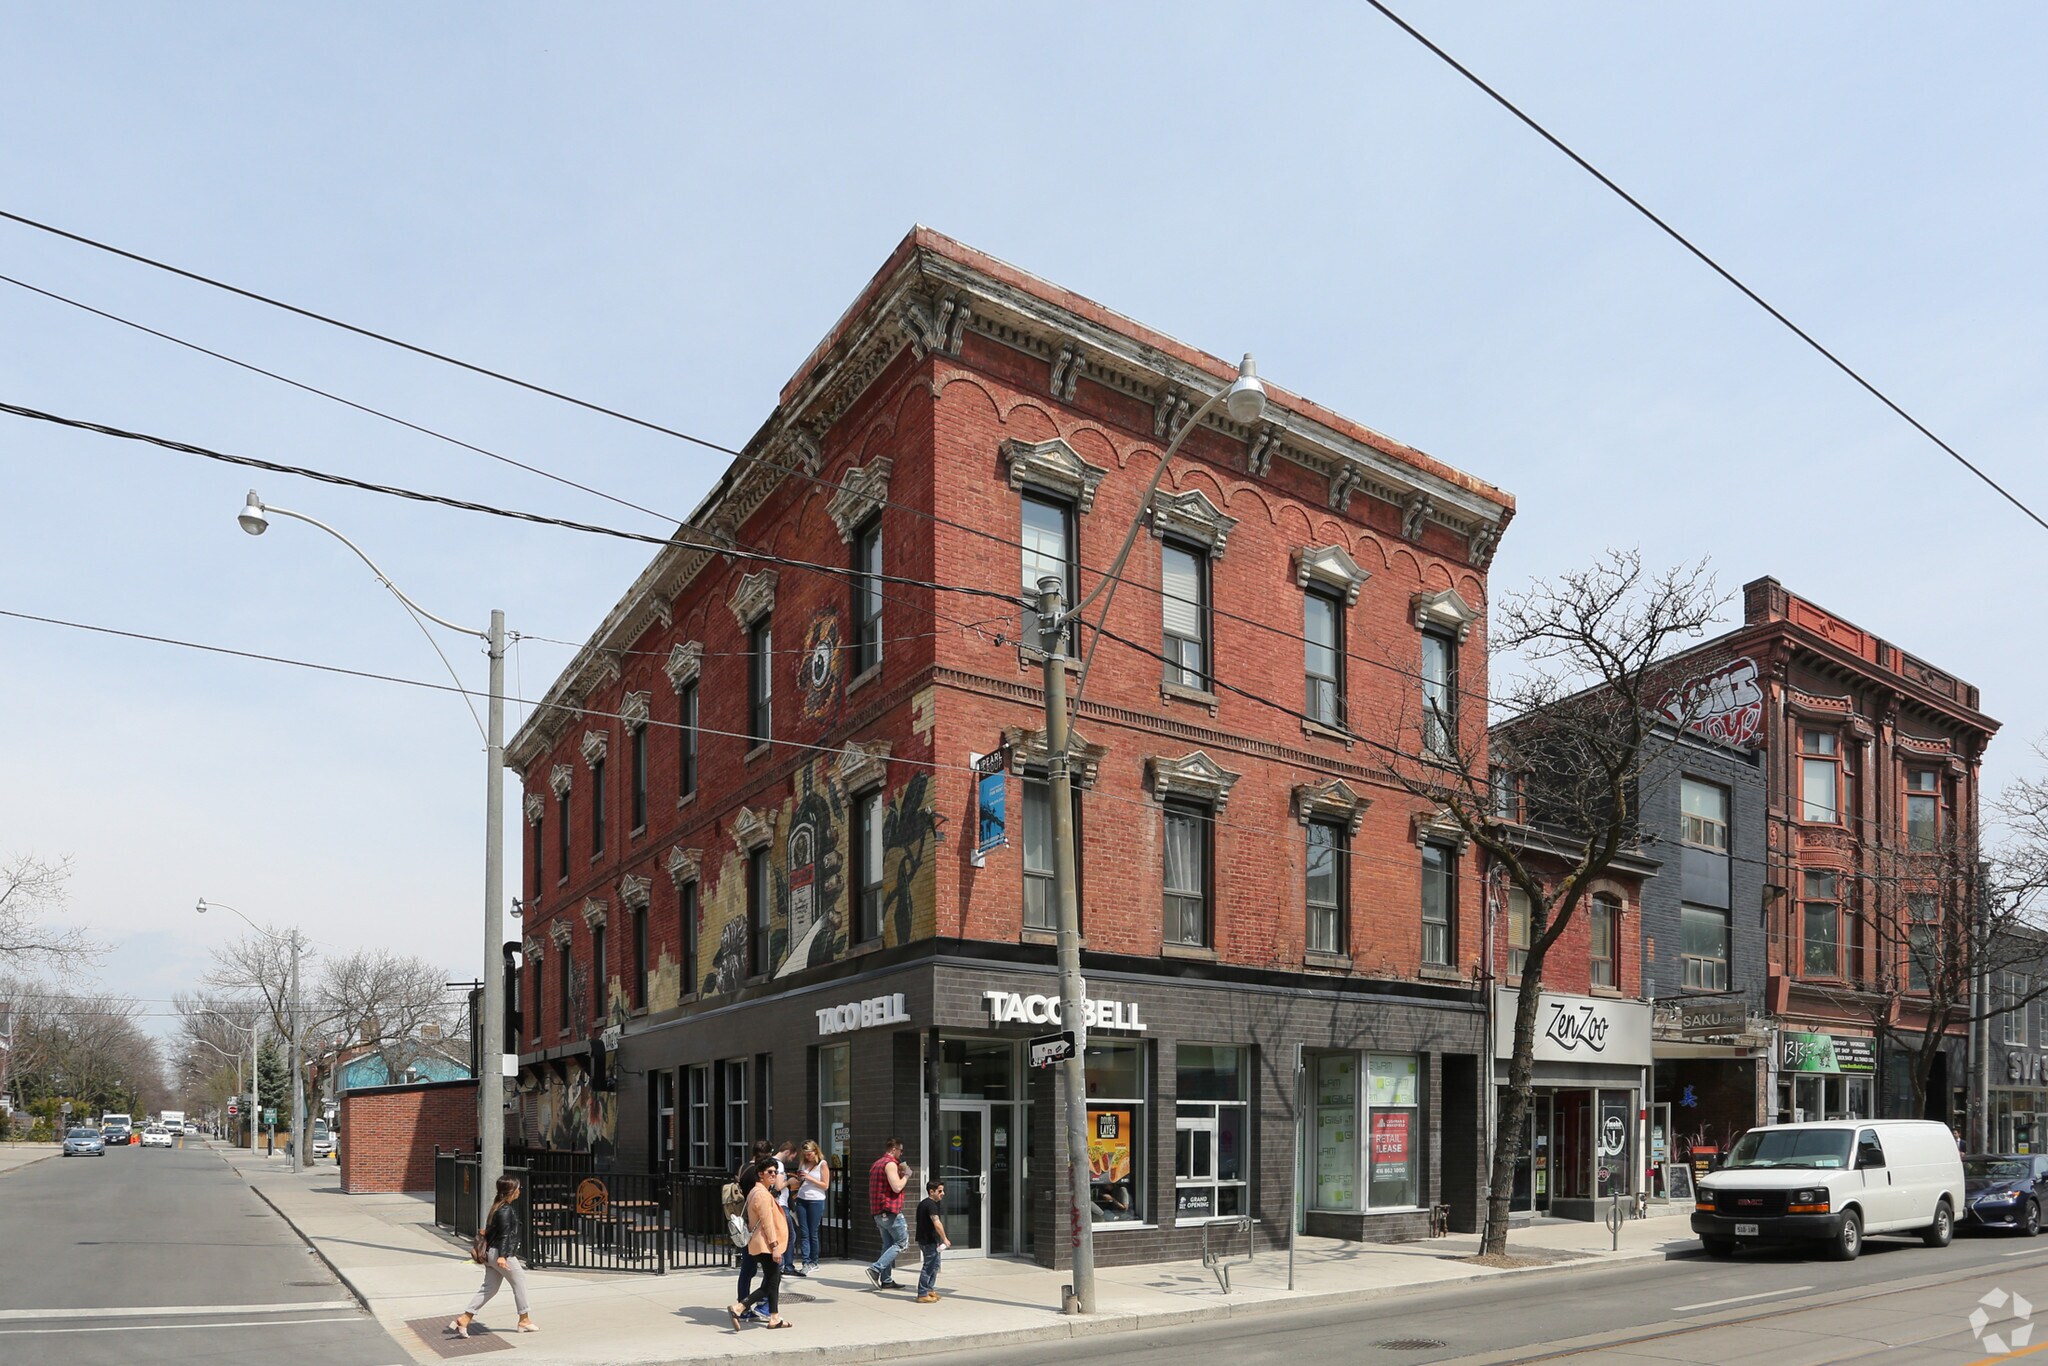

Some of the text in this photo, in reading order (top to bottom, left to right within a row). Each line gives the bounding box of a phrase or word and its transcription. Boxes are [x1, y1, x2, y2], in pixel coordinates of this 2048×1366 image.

[982, 751, 1003, 767] PEARL
[816, 993, 911, 1035] TACO BELL
[1683, 1013, 1744, 1027] SAKU SUSHI
[1100, 1116, 1116, 1125] DOUBLE
[1100, 1124, 1116, 1135] LAYER
[1375, 1134, 1402, 1143] RETAIL
[1379, 1144, 1402, 1153] LEASE
